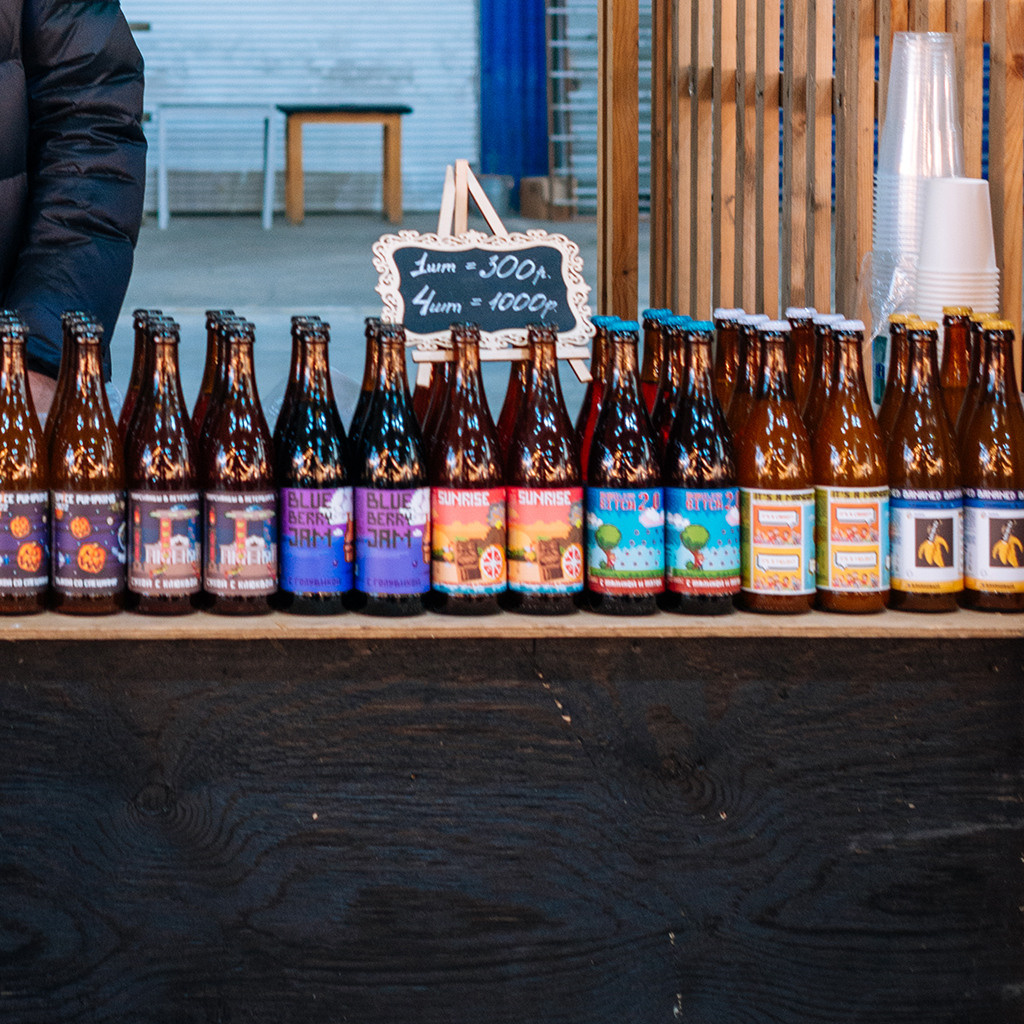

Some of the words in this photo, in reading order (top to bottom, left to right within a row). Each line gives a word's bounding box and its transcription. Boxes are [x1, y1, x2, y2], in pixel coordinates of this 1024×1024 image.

[288, 491, 332, 508] BLUE
[367, 492, 412, 509] BLUE
[438, 489, 490, 506] SUNRISE
[517, 489, 571, 506] SUNRISE
[288, 511, 333, 525] BERRY
[367, 511, 413, 525] BERRY
[288, 528, 332, 548] JAM
[367, 529, 412, 549] JAM
